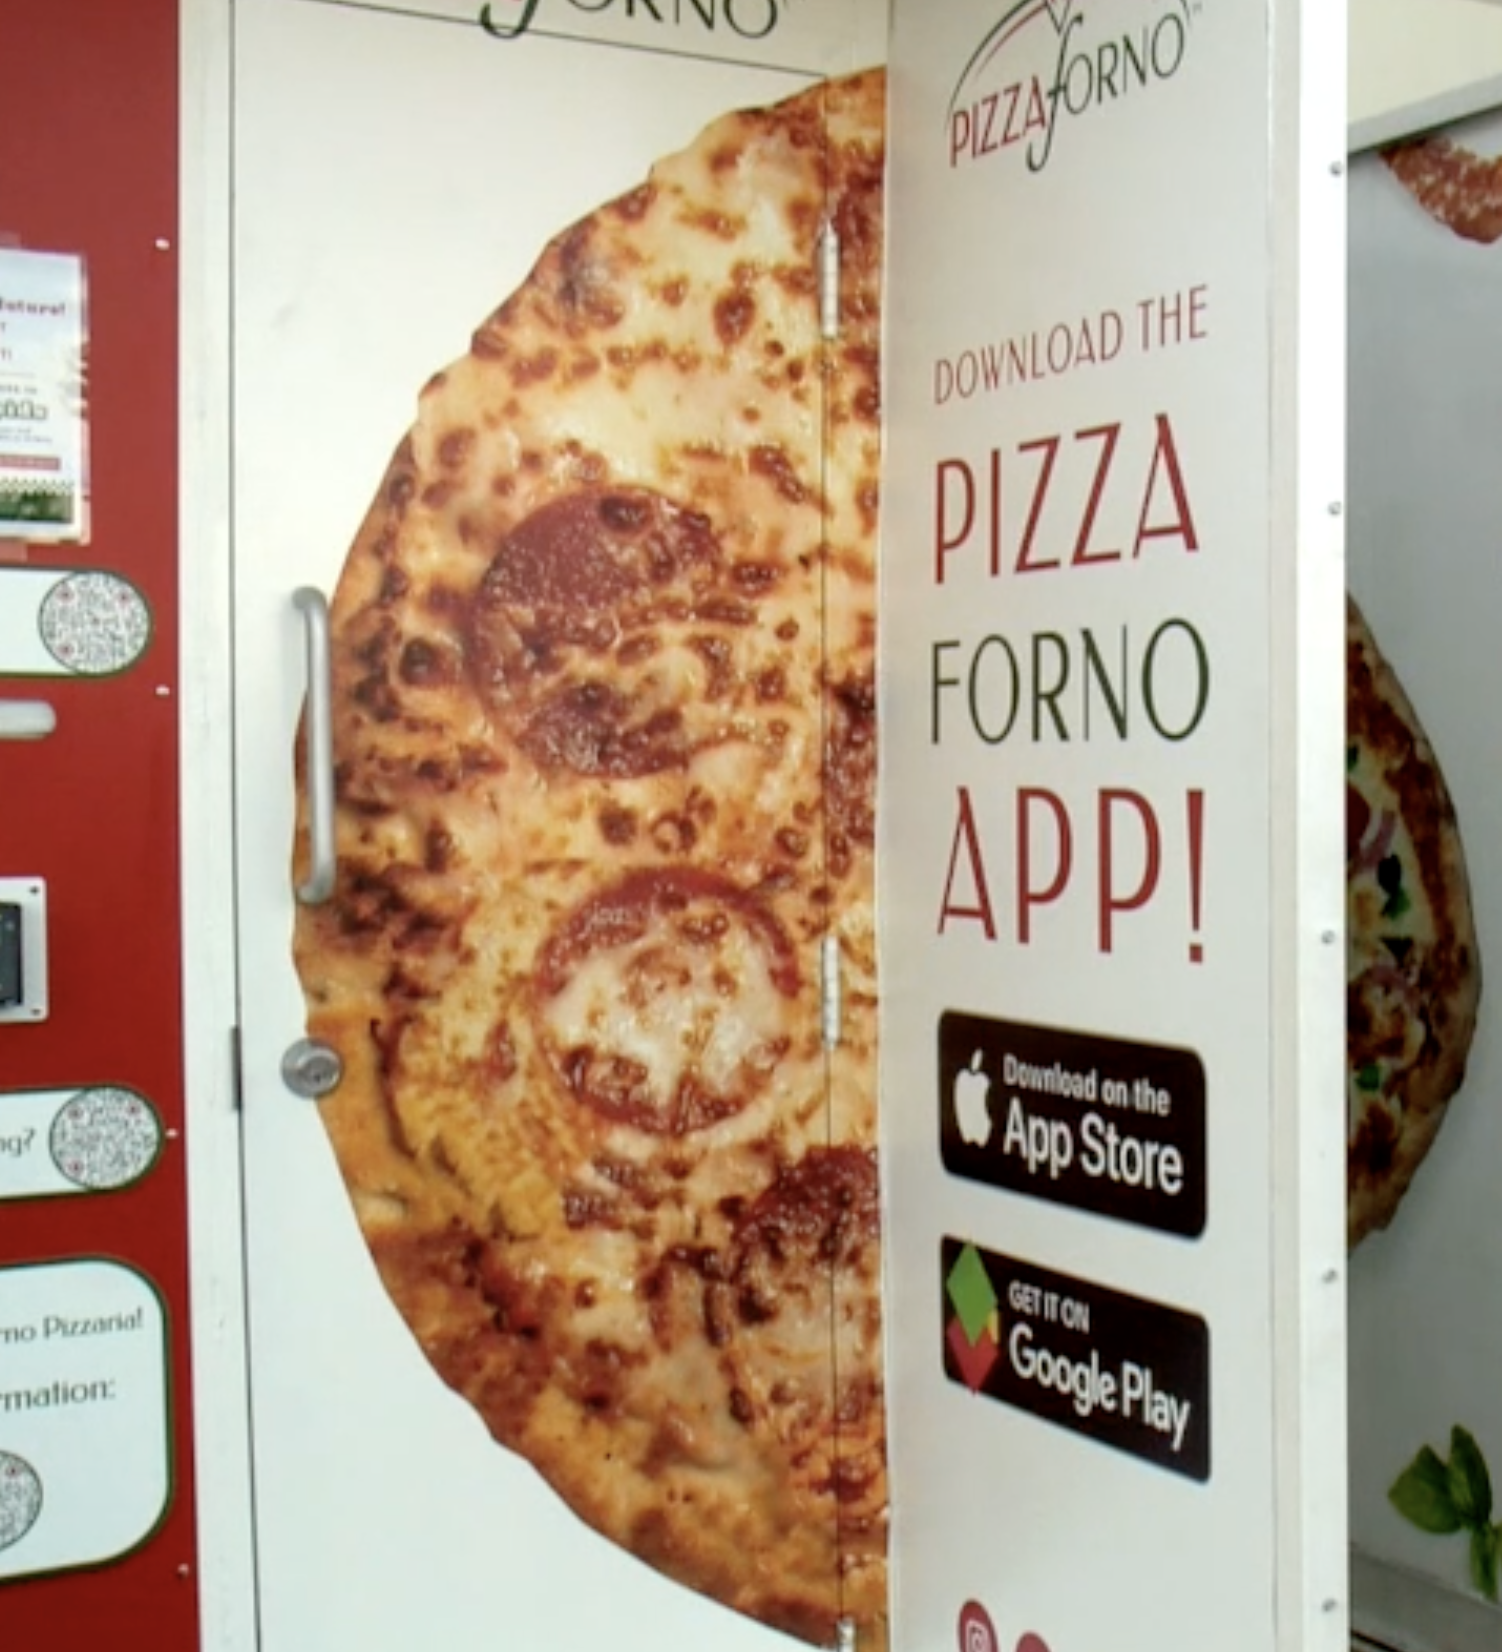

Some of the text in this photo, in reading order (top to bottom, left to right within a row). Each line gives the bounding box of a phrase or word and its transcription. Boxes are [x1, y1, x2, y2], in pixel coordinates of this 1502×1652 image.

[934, 284, 1208, 405] DOWNLOAD THE
[935, 412, 1200, 586] PIZZA
[931, 617, 1210, 746] FORNO
[937, 786, 1205, 964] APP!
[1003, 1052, 1172, 1118] Download on the
[1003, 1095, 1185, 1196] App Store
[1007, 1279, 1091, 1335] GET IT ON
[1008, 1321, 1191, 1453] Google Play
